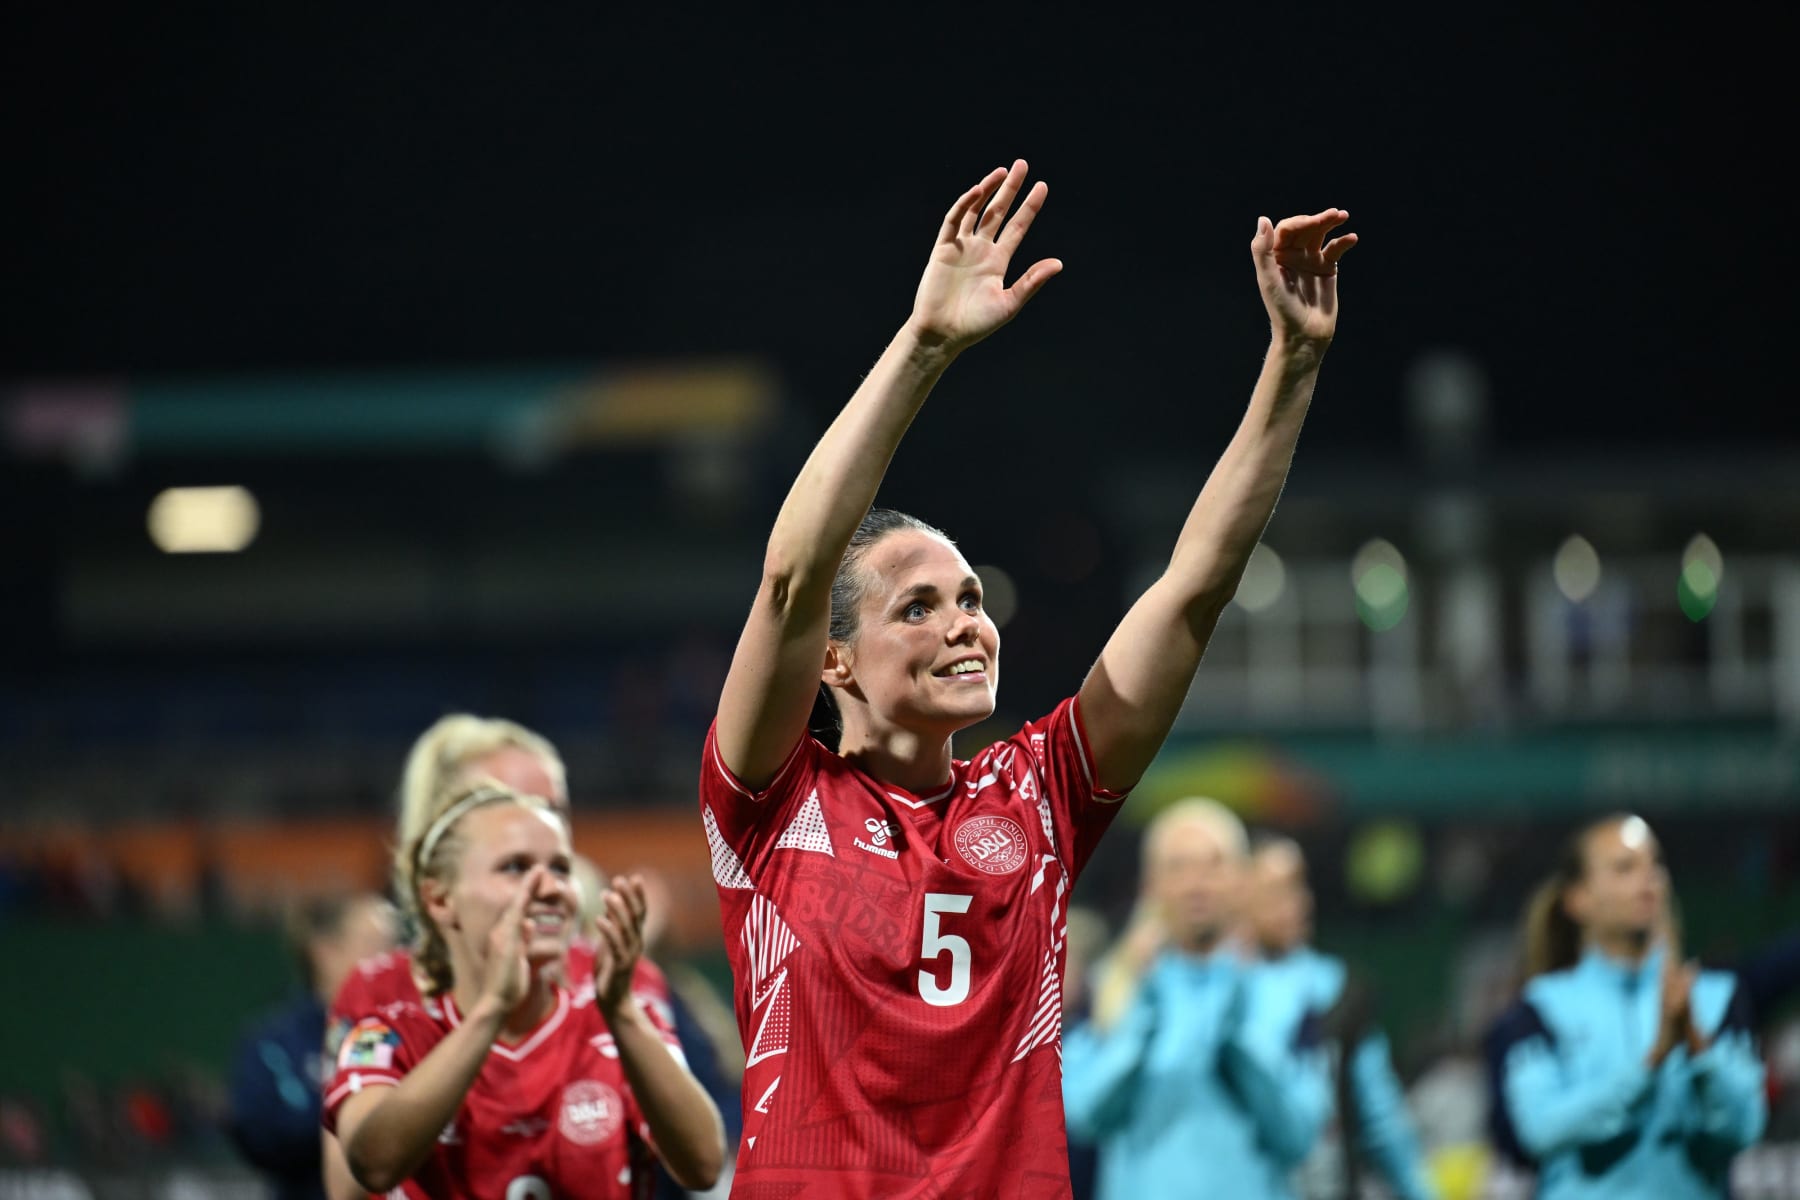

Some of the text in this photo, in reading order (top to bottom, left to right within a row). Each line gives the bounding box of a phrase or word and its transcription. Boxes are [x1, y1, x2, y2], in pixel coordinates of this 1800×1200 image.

[853, 836, 899, 860] hummel
[969, 829, 1012, 860] DBU
[1001, 820, 1025, 850] UNION
[918, 893, 974, 1007] 5
